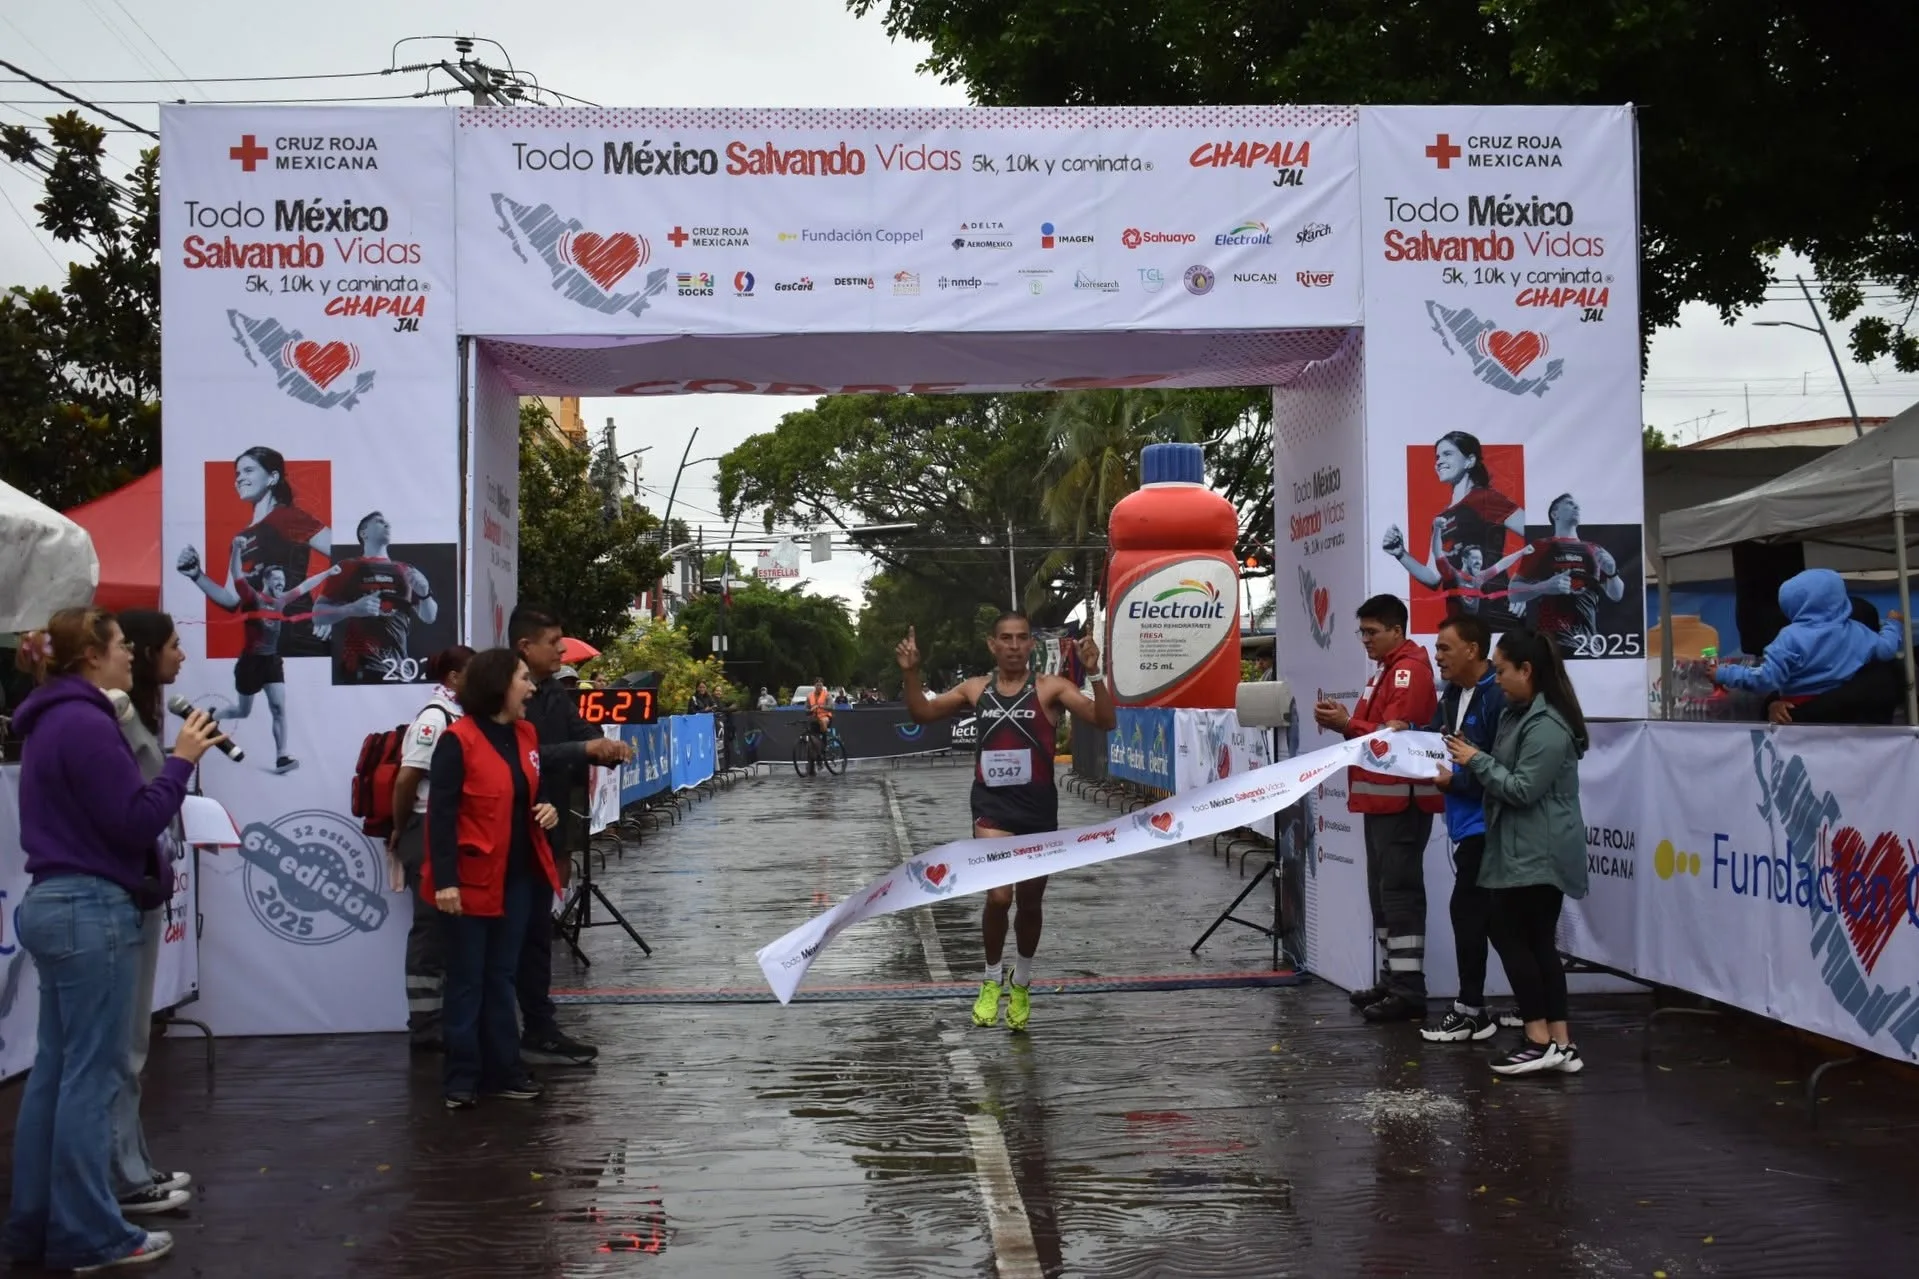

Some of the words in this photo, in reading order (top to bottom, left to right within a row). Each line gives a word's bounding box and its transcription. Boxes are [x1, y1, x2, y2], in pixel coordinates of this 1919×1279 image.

[275, 137, 324, 151] CRUZ
[330, 137, 378, 151] ROJA
[1468, 136, 1512, 149] CRUZ
[1517, 136, 1562, 149] ROJA
[512, 142, 593, 170] Todo
[603, 140, 718, 175] México
[726, 141, 865, 175] Salvando
[875, 143, 961, 171] Vidas
[971, 154, 999, 175] 5k,
[1006, 154, 1039, 172] 10k
[1044, 158, 1056, 175] y
[1189, 141, 1310, 168] CHAPALA
[1468, 154, 1562, 167] MEXICANA
[275, 156, 378, 170] MEXICANA
[1273, 168, 1304, 187] JAL
[184, 201, 265, 228] Todo
[275, 199, 388, 232] México
[1384, 196, 1459, 222] Todo
[1468, 194, 1574, 227] México
[692, 227, 719, 236] CRUZ
[722, 227, 749, 236] ROJA
[802, 229, 872, 241] Fundación
[876, 229, 924, 244] Coppel
[1143, 232, 1196, 244] Sahuayo
[1215, 233, 1272, 245] Electrolit
[692, 238, 749, 247] MEXICANA
[1384, 229, 1514, 262] Salvando
[1523, 231, 1604, 257] Vidas
[183, 235, 324, 269] Salvando
[334, 237, 421, 264] Vidas
[246, 275, 274, 295] 5k,
[280, 275, 314, 292] 10k
[320, 278, 331, 293] y
[951, 277, 982, 288] nmdp
[1234, 273, 1277, 282] NUCAN
[1296, 271, 1334, 287] River
[1442, 267, 1468, 287] 5k,
[1474, 267, 1505, 283] 10k
[1511, 271, 1521, 287] y
[678, 288, 714, 296] SOCKS
[775, 281, 814, 291] GasCard
[1515, 287, 1609, 307] CHAPALA
[324, 295, 427, 317] CHAPALA
[1580, 308, 1603, 322] JAL
[393, 317, 419, 333] JAL
[758, 569, 799, 577] ESTRELLAS
[1129, 601, 1225, 619] Electrolit
[1573, 633, 1641, 658] 2025
[1140, 662, 1158, 670] 625
[1161, 662, 1174, 670] mL
[951, 725, 978, 737] lect
[988, 766, 1022, 778] 0347
[1585, 826, 1601, 846] UZ
[1603, 828, 1635, 851] ROJA
[293, 825, 314, 839] 32
[318, 827, 366, 880] estados
[1587, 854, 1634, 880] XICANA
[243, 831, 282, 857] 6ta
[279, 854, 383, 928] edición
[1713, 832, 1892, 924] Fundación
[256, 885, 315, 936] 2025
